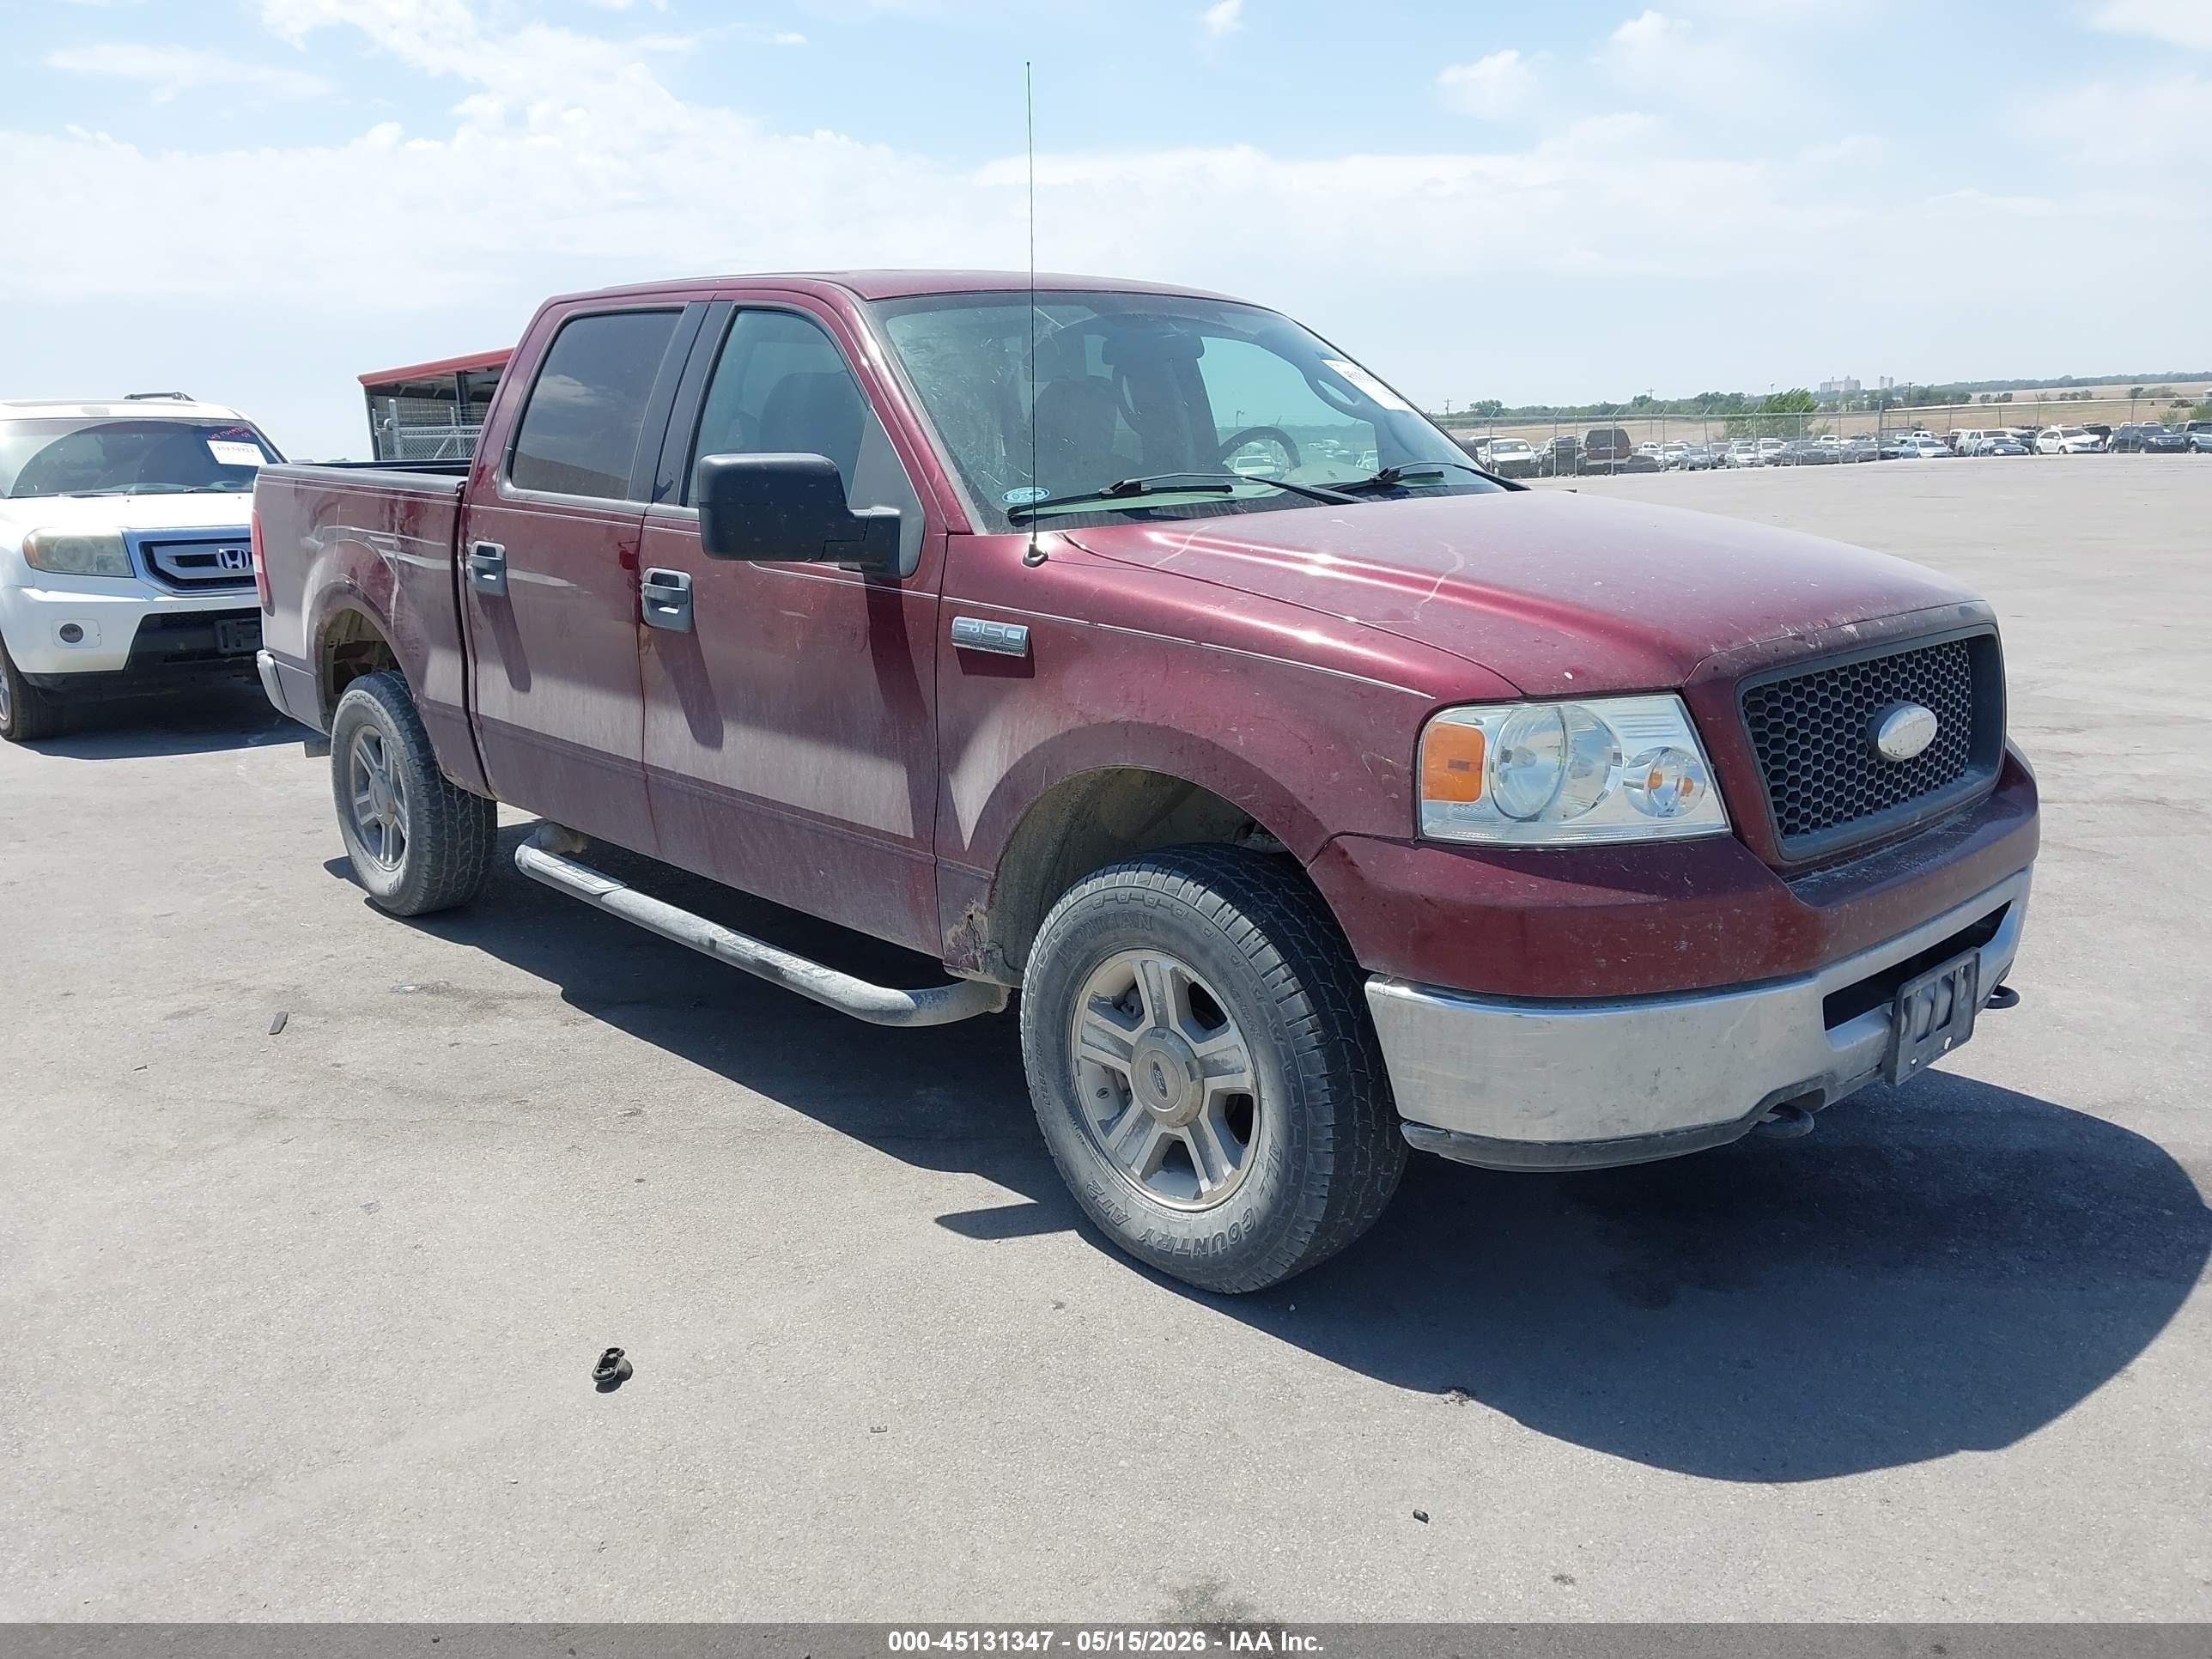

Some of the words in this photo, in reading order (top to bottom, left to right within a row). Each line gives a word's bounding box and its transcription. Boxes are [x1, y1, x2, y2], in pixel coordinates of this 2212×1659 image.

[1258, 1130, 1283, 1200] ALL
[1086, 1180, 1132, 1226] AT2
[1137, 1208, 1256, 1257] COUNTRY
